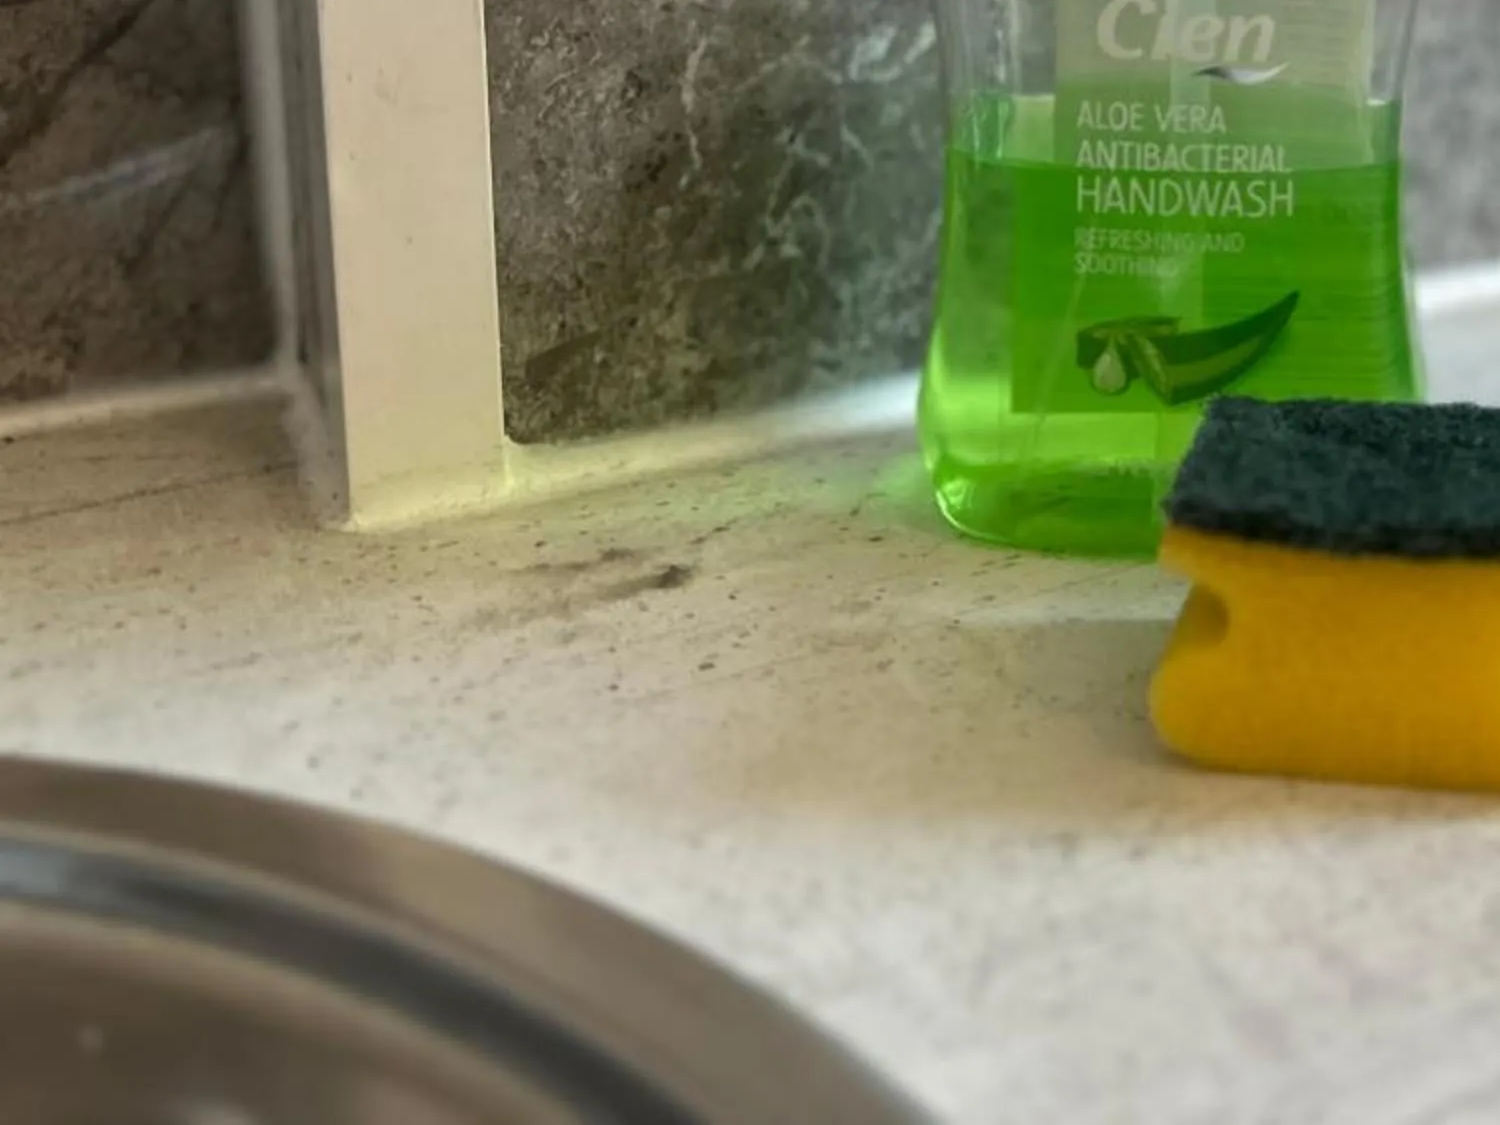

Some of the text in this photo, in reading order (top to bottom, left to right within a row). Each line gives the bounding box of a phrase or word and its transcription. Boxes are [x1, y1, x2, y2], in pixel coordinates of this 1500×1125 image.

[1076, 100, 1227, 135] ALOE VERA
[1075, 139, 1293, 173] ANTIBACTERIAL
[1076, 174, 1294, 217] HANDWASH
[1201, 230, 1246, 254] AND
